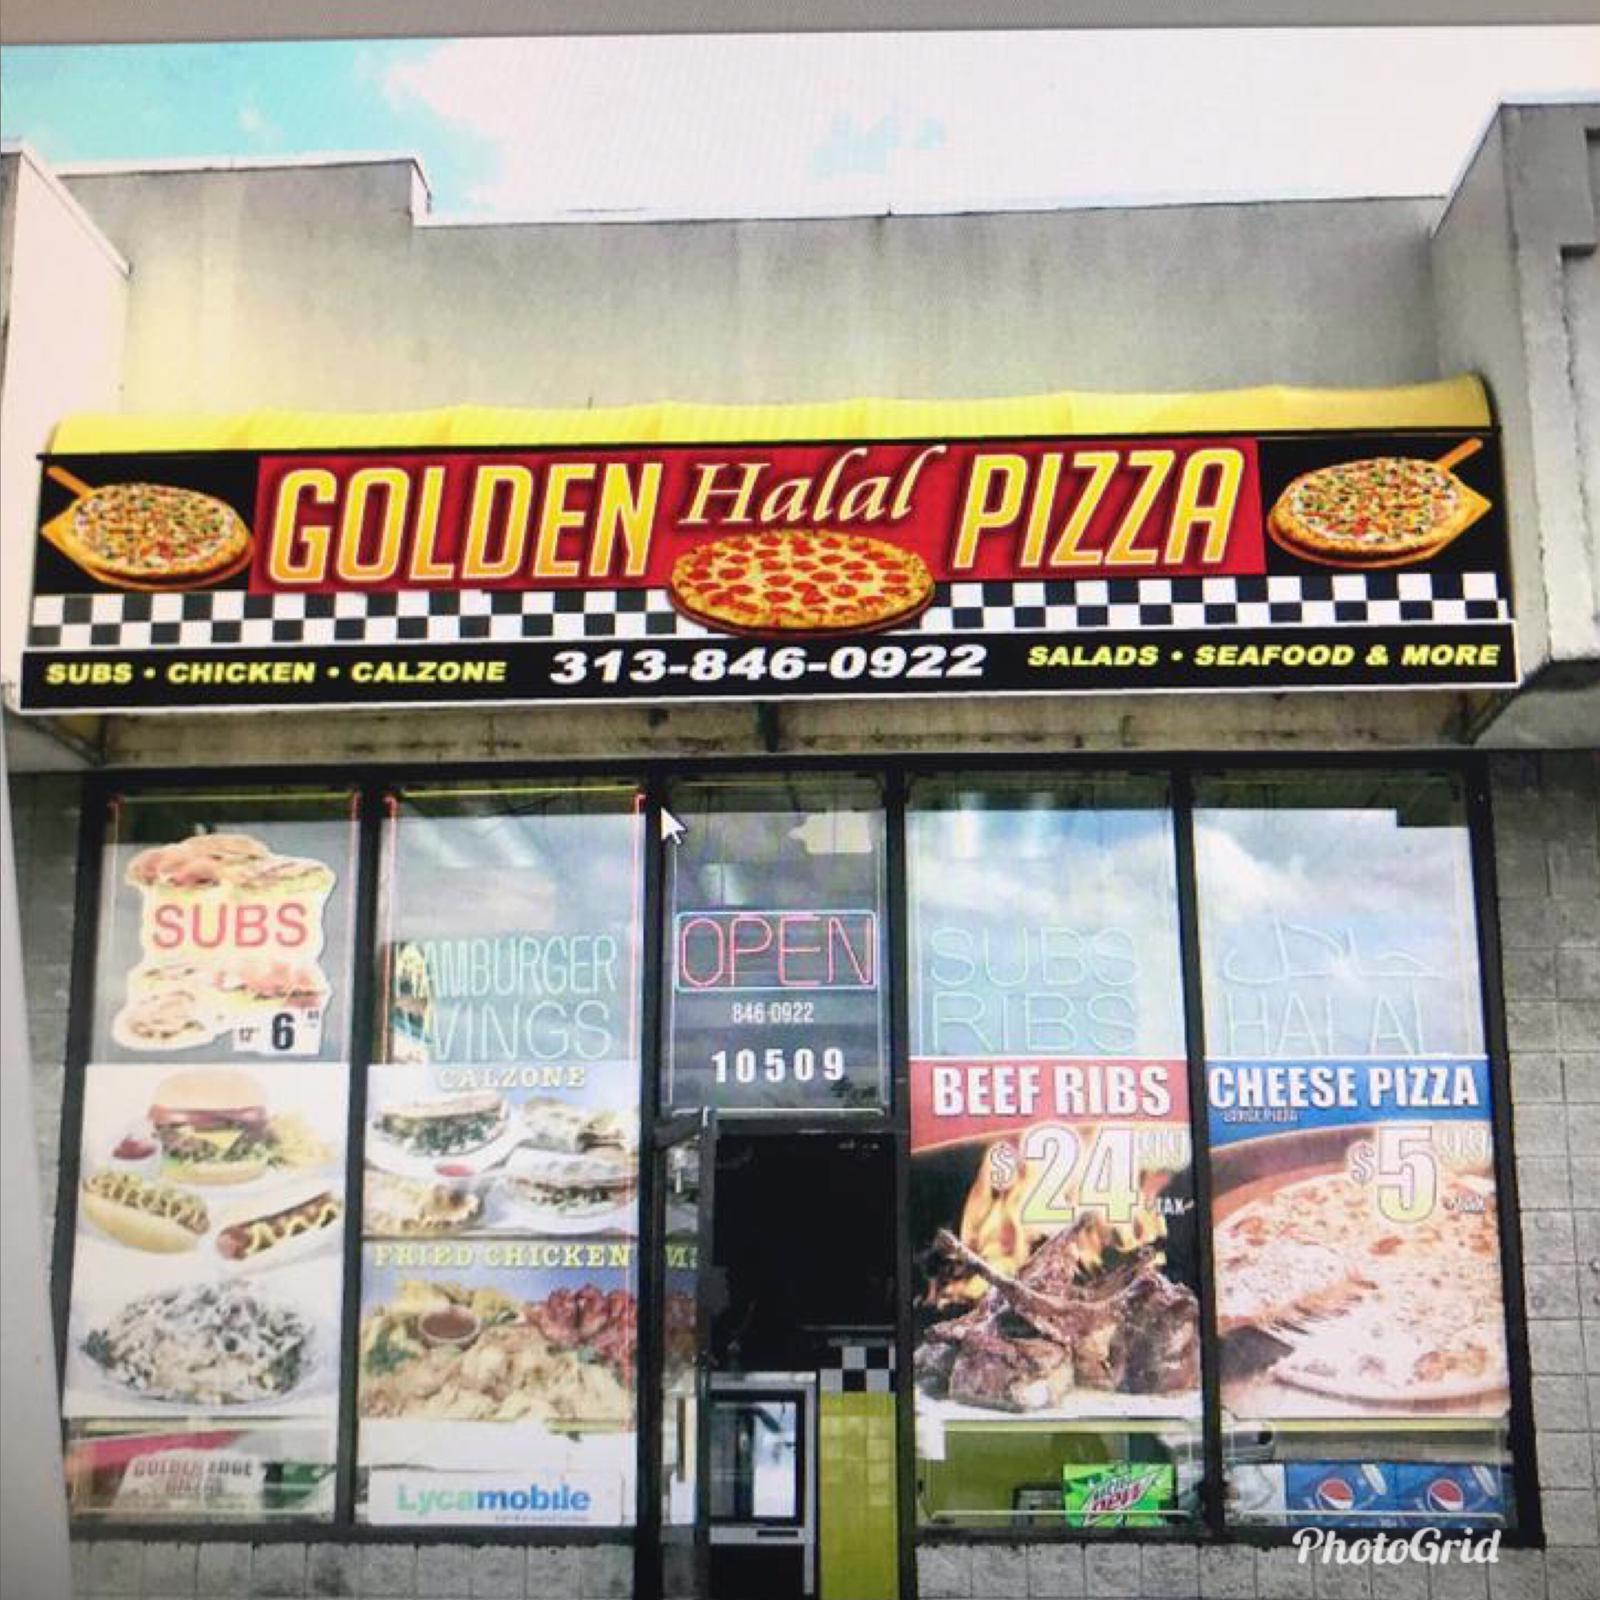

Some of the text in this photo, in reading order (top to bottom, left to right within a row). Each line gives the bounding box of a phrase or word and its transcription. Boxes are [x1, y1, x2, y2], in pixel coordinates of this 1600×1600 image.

[266, 444, 1246, 585] GOLDEN Halal PIZZA
[46, 659, 507, 685] SUBS CHICKEN CALZONE
[549, 644, 987, 685] 313-846-0922
[1027, 643, 1500, 668] SALADS SEAFOOD & MORE
[152, 902, 309, 949] SUBS
[682, 916, 873, 987] OPEN
[929, 926, 1142, 988] SUBS
[932, 990, 1138, 1053] RIBS
[440, 1066, 586, 1089] CALZONE
[711, 1047, 845, 1084] 10509
[1208, 1064, 1480, 1109] CHEESE PIZZA
[931, 1065, 1172, 1118] BEEF RIBS
[374, 1243, 632, 1268] FRIED CHICKEN
[397, 1483, 591, 1516] Lycamobile
